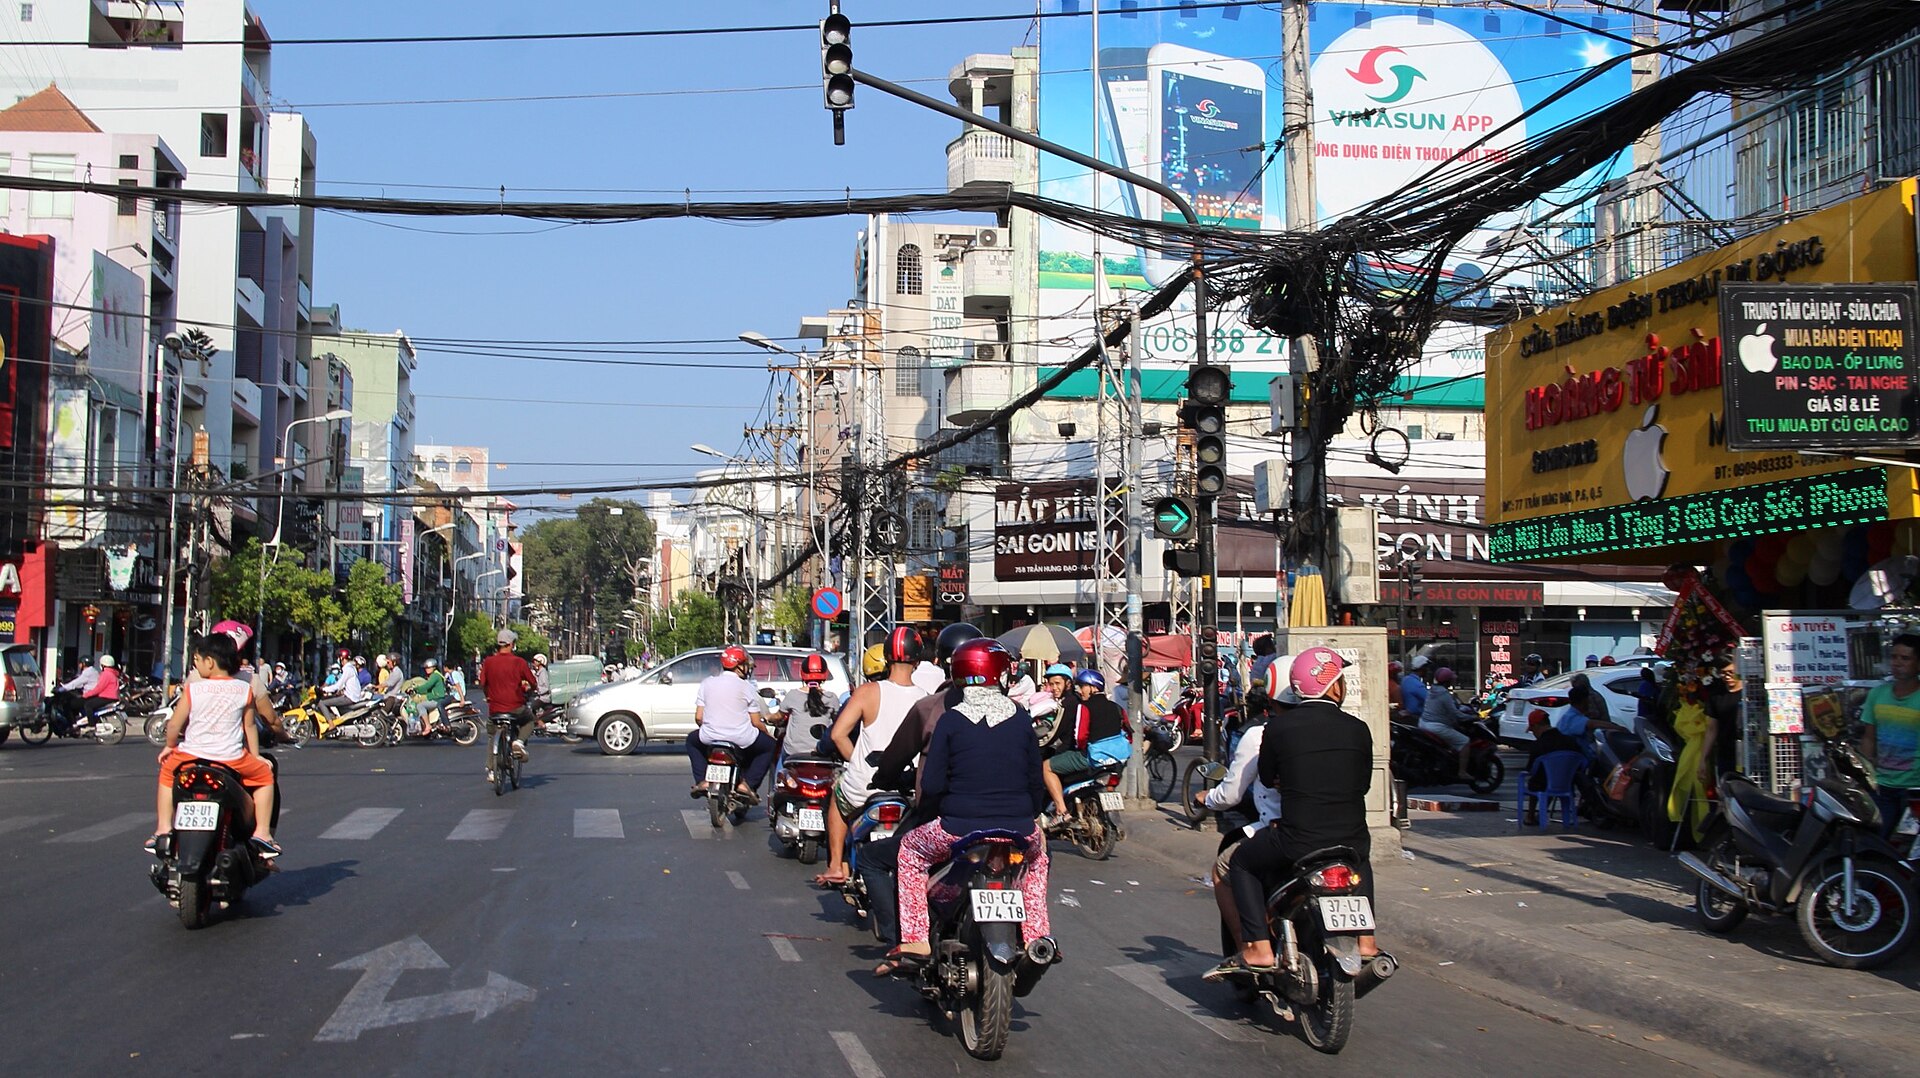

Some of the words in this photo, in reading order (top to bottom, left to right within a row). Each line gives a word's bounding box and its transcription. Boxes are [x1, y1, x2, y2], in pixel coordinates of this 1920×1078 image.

[1328, 109, 1445, 131] VINASUN
[1452, 114, 1494, 132] APP
[936, 296, 957, 310] DAT
[1742, 302, 1778, 320] TRUNG
[1779, 299, 1801, 320] TÂM
[1802, 299, 1820, 320] CÀI
[1848, 298, 1872, 321] SỬA
[1872, 299, 1902, 321] CHỮA
[931, 336, 960, 351] CORP
[1785, 328, 1811, 347] MUA
[1813, 325, 1837, 347] BÁN
[1838, 328, 1867, 351] ĐIỆN
[1867, 329, 1903, 351] THOẠI
[1782, 356, 1811, 370] BAO
[1815, 356, 1834, 370] DA
[1844, 352, 1863, 370] ỐP
[1867, 356, 1904, 370] LƯNG
[1776, 376, 1798, 390] PIN
[1808, 376, 1837, 393] SẠC
[1847, 376, 1868, 390] TAI
[1871, 376, 1909, 390] NGHE
[1525, 364, 1624, 430] HOÀNG
[1807, 395, 1832, 412] GIÁ
[1850, 398, 1860, 412] &
[1747, 418, 1775, 432] THU
[1778, 418, 1808, 432] MUA
[1810, 418, 1829, 432] ĐT
[1832, 415, 1850, 432] CŨ
[1854, 415, 1878, 432] GIÁ
[1880, 417, 1910, 432] CAO
[996, 486, 1049, 527] MẮT
[1360, 484, 1480, 524] KÍNH
[1668, 504, 1681, 533] 3
[996, 534, 1025, 555] SAI
[1027, 532, 1071, 553] GON
[1074, 529, 1119, 551] NEW
[942, 564, 965, 578] MẮT
[941, 580, 966, 592] KÍNH
[1426, 584, 1453, 601] SÀI
[1455, 584, 1490, 601] GÒN
[1493, 587, 1529, 601] NEW
[1781, 617, 1801, 633] CẦN
[183, 804, 212, 816] 59-U1
[177, 816, 214, 828] 426.26
[979, 891, 1017, 905] 60-C2
[1327, 899, 1361, 913] 37-L7
[976, 905, 1024, 919] 174.18
[1330, 913, 1367, 928] 6798
